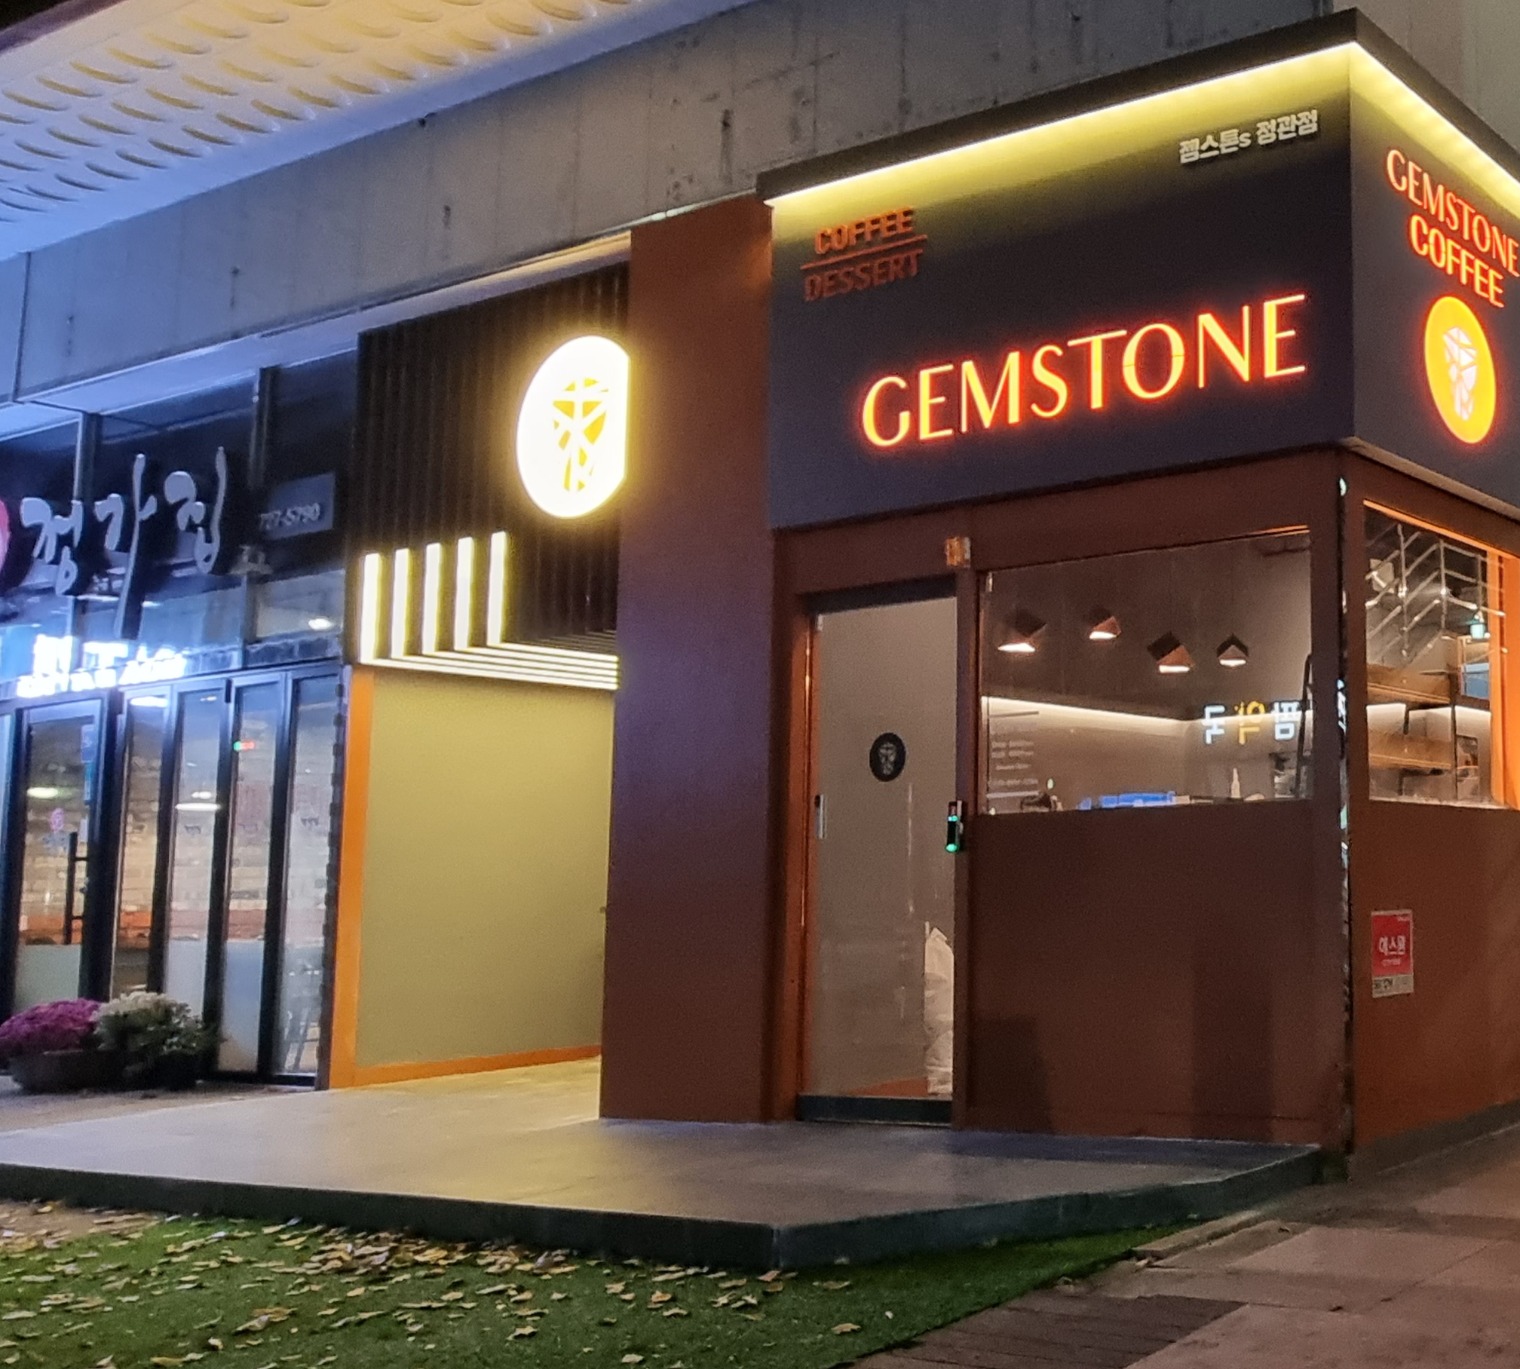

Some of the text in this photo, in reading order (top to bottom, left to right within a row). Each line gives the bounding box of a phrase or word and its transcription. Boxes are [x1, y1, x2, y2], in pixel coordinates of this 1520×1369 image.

[1256, 109, 1318, 146] 정관점
[815, 205, 914, 255] COFFEE
[1387, 149, 1520, 278] GEMSTONE
[805, 247, 924, 302] DESSERT
[1410, 214, 1504, 308] COFFEE
[862, 294, 1306, 447] GEMSTONE
